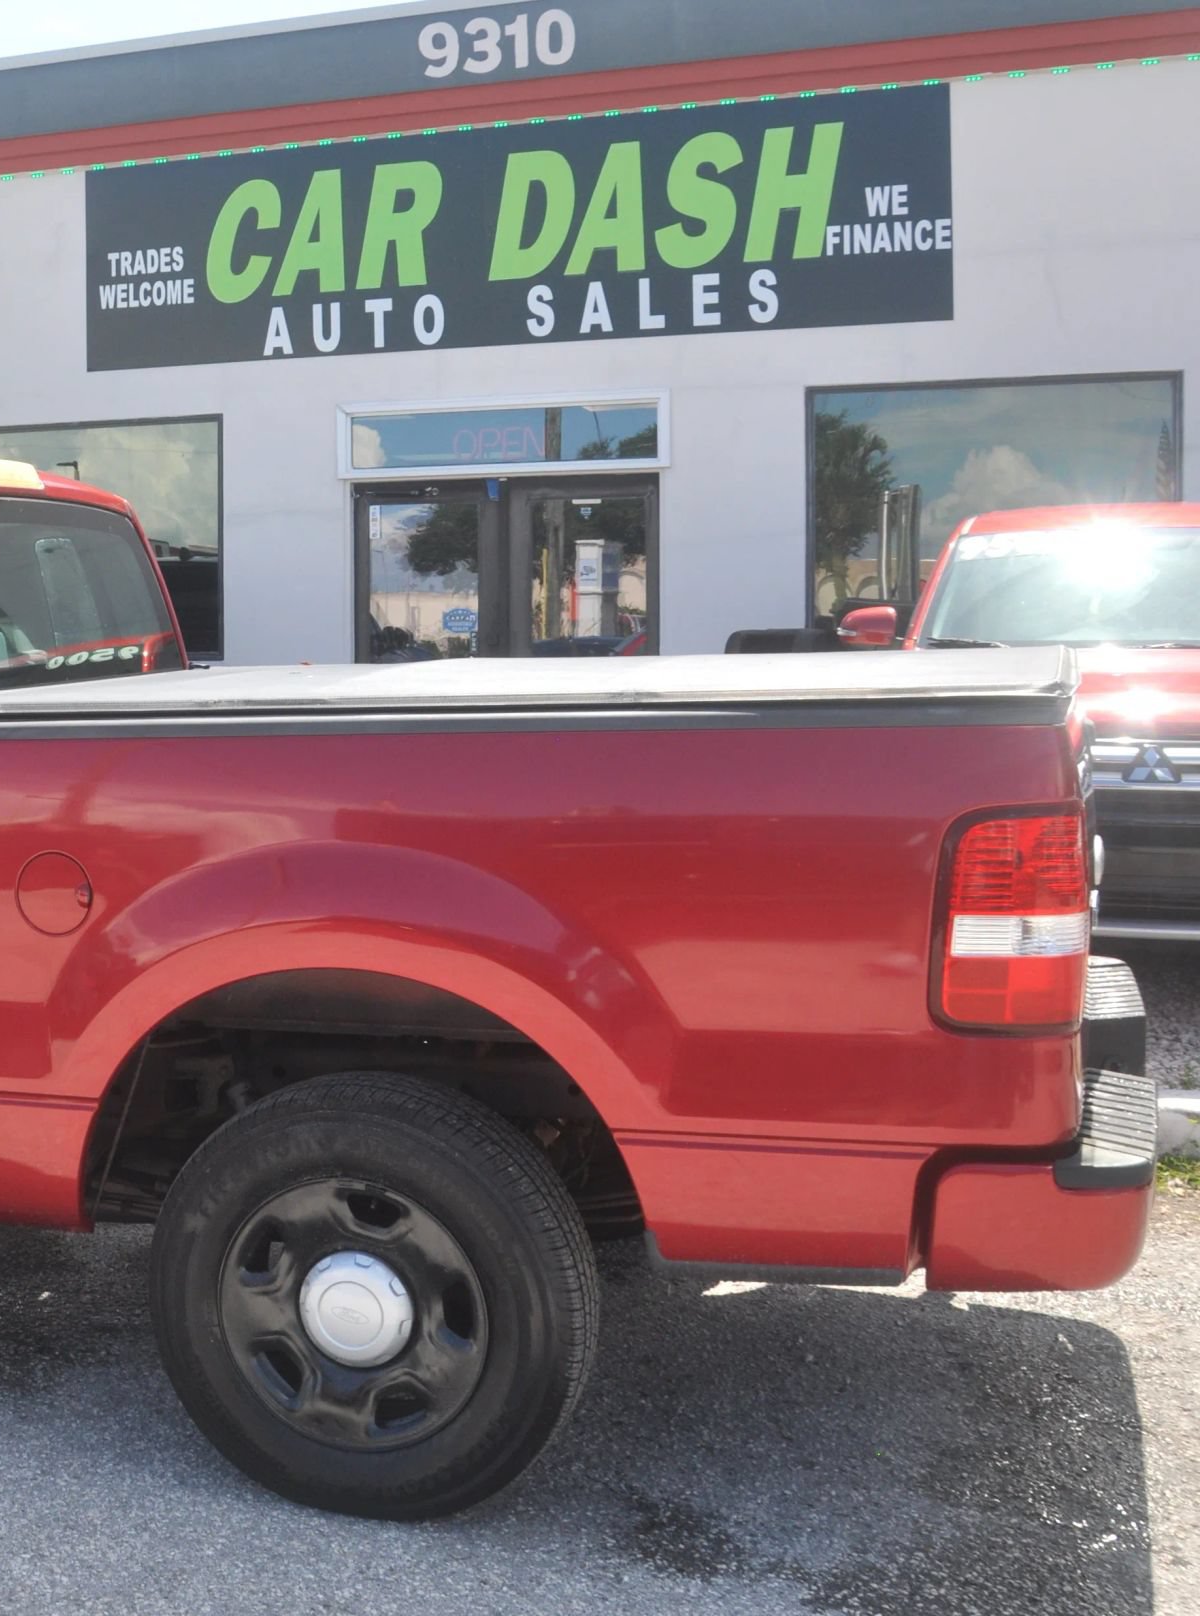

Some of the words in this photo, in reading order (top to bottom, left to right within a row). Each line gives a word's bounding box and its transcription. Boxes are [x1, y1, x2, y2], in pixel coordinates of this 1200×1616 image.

[418, 8, 576, 78] 9310
[205, 160, 443, 304] CAR
[488, 121, 845, 284] DASH
[865, 184, 910, 217] WE
[825, 218, 953, 257] FINANCE
[107, 245, 185, 278] TRADES
[98, 277, 196, 311] WELCOME
[262, 293, 447, 358] AUTO
[525, 267, 781, 338] SALES
[451, 426, 545, 460] OPEN
